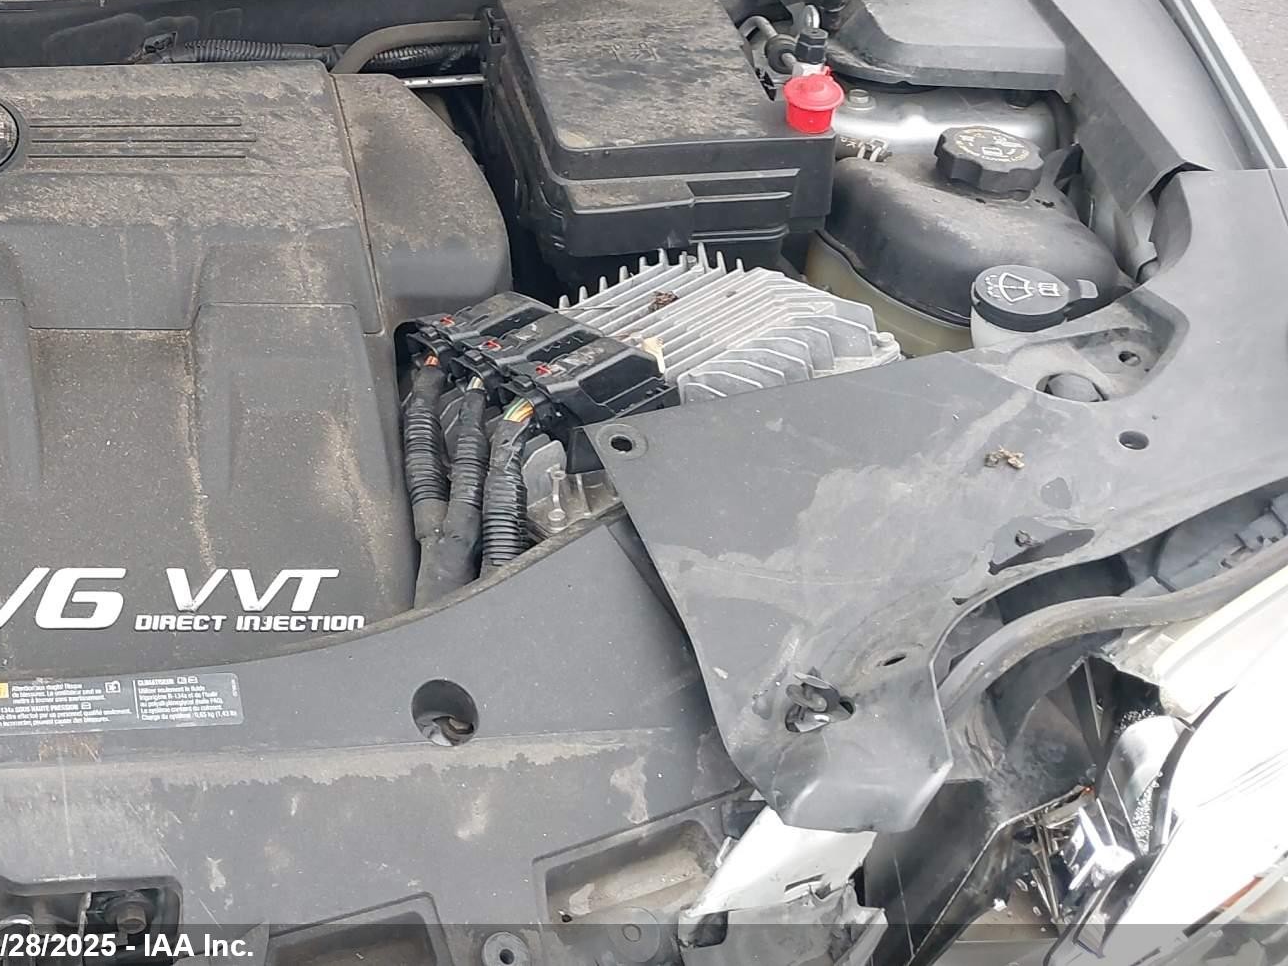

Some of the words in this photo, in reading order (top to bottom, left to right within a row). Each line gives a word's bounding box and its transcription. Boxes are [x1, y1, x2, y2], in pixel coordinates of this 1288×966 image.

[166, 568, 340, 612] VVT
[134, 614, 227, 631] DIRECT
[236, 614, 365, 631] INJECTION
